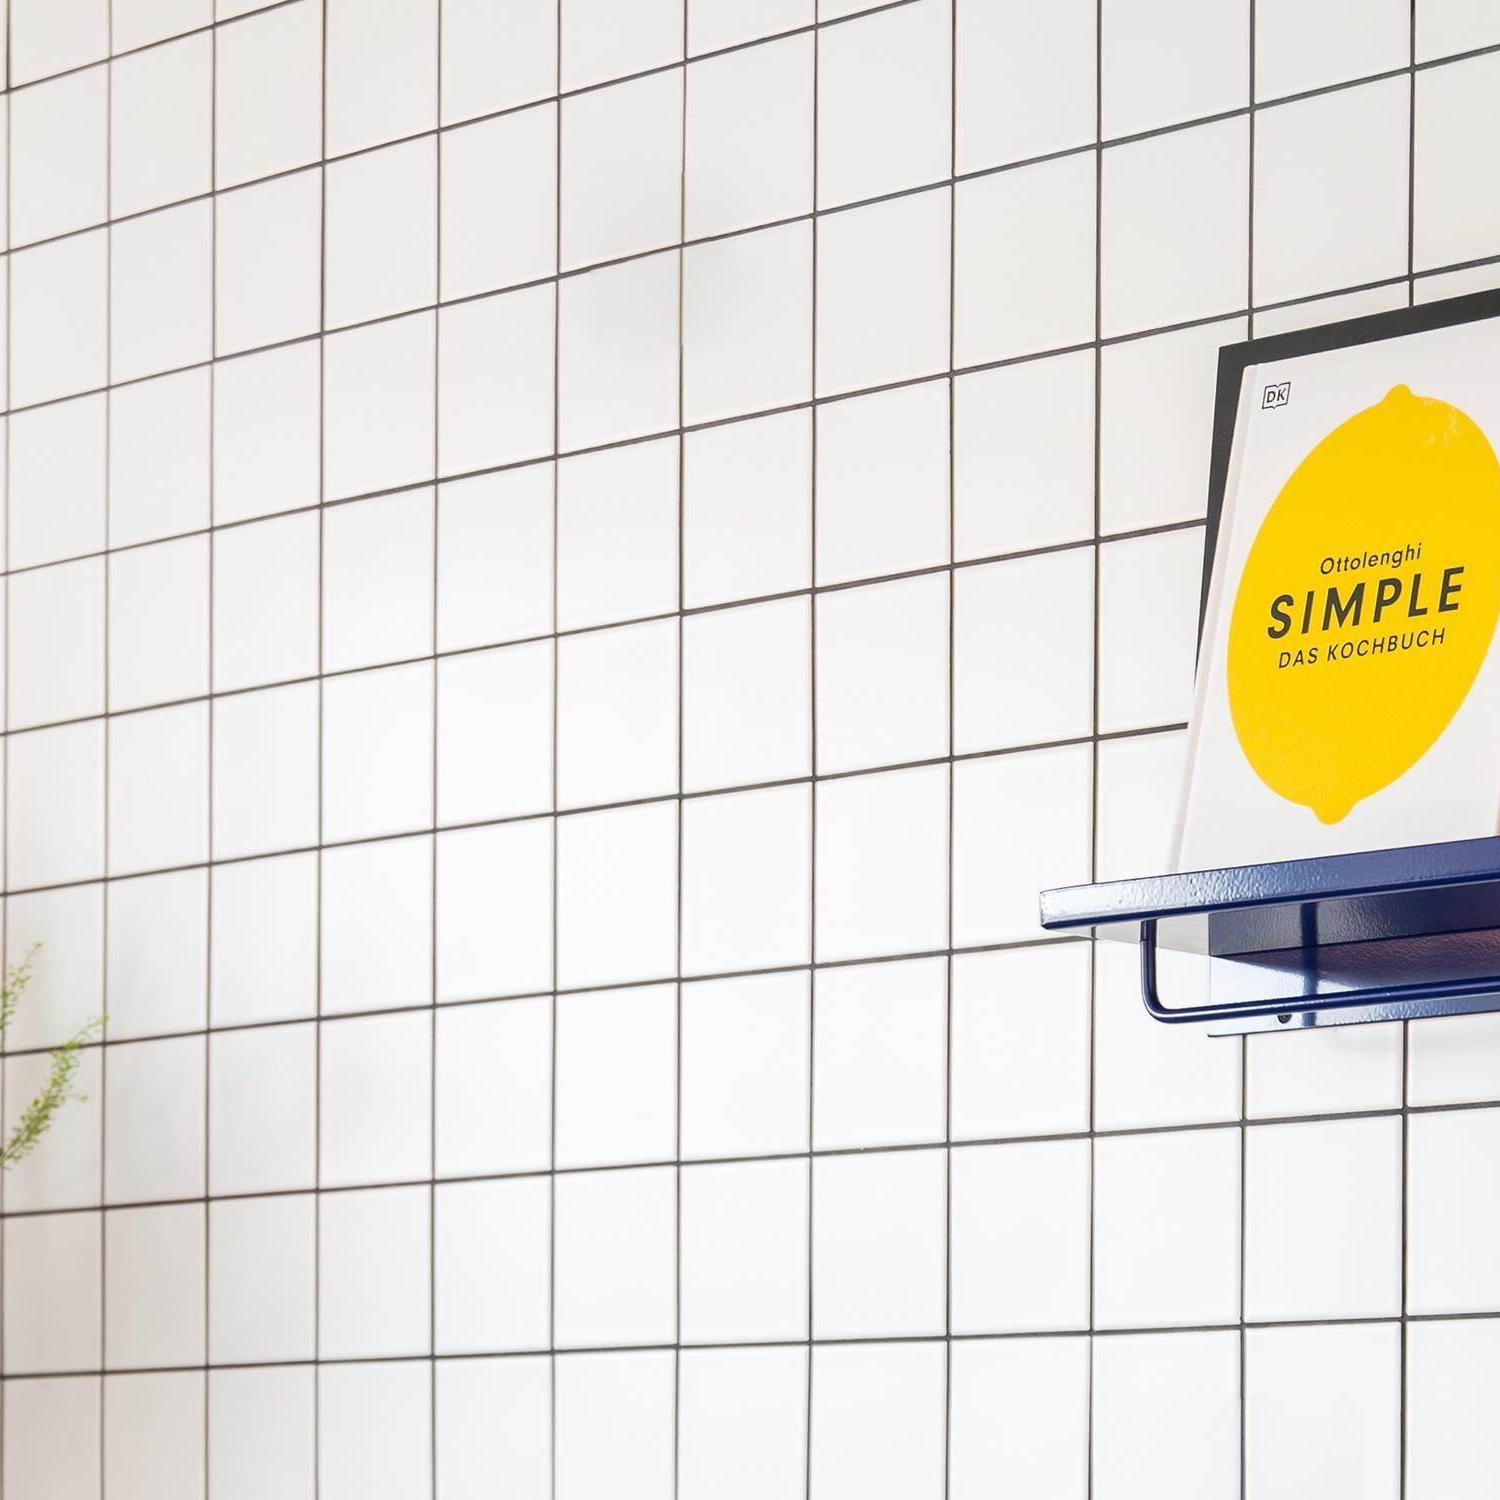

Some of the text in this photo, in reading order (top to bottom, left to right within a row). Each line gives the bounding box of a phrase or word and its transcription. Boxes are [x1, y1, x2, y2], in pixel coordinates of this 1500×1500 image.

[1320, 543, 1422, 576] Ottolenghi
[1268, 566, 1465, 639] SIMPLE
[1278, 628, 1446, 669] DAS KOCHBUCH
